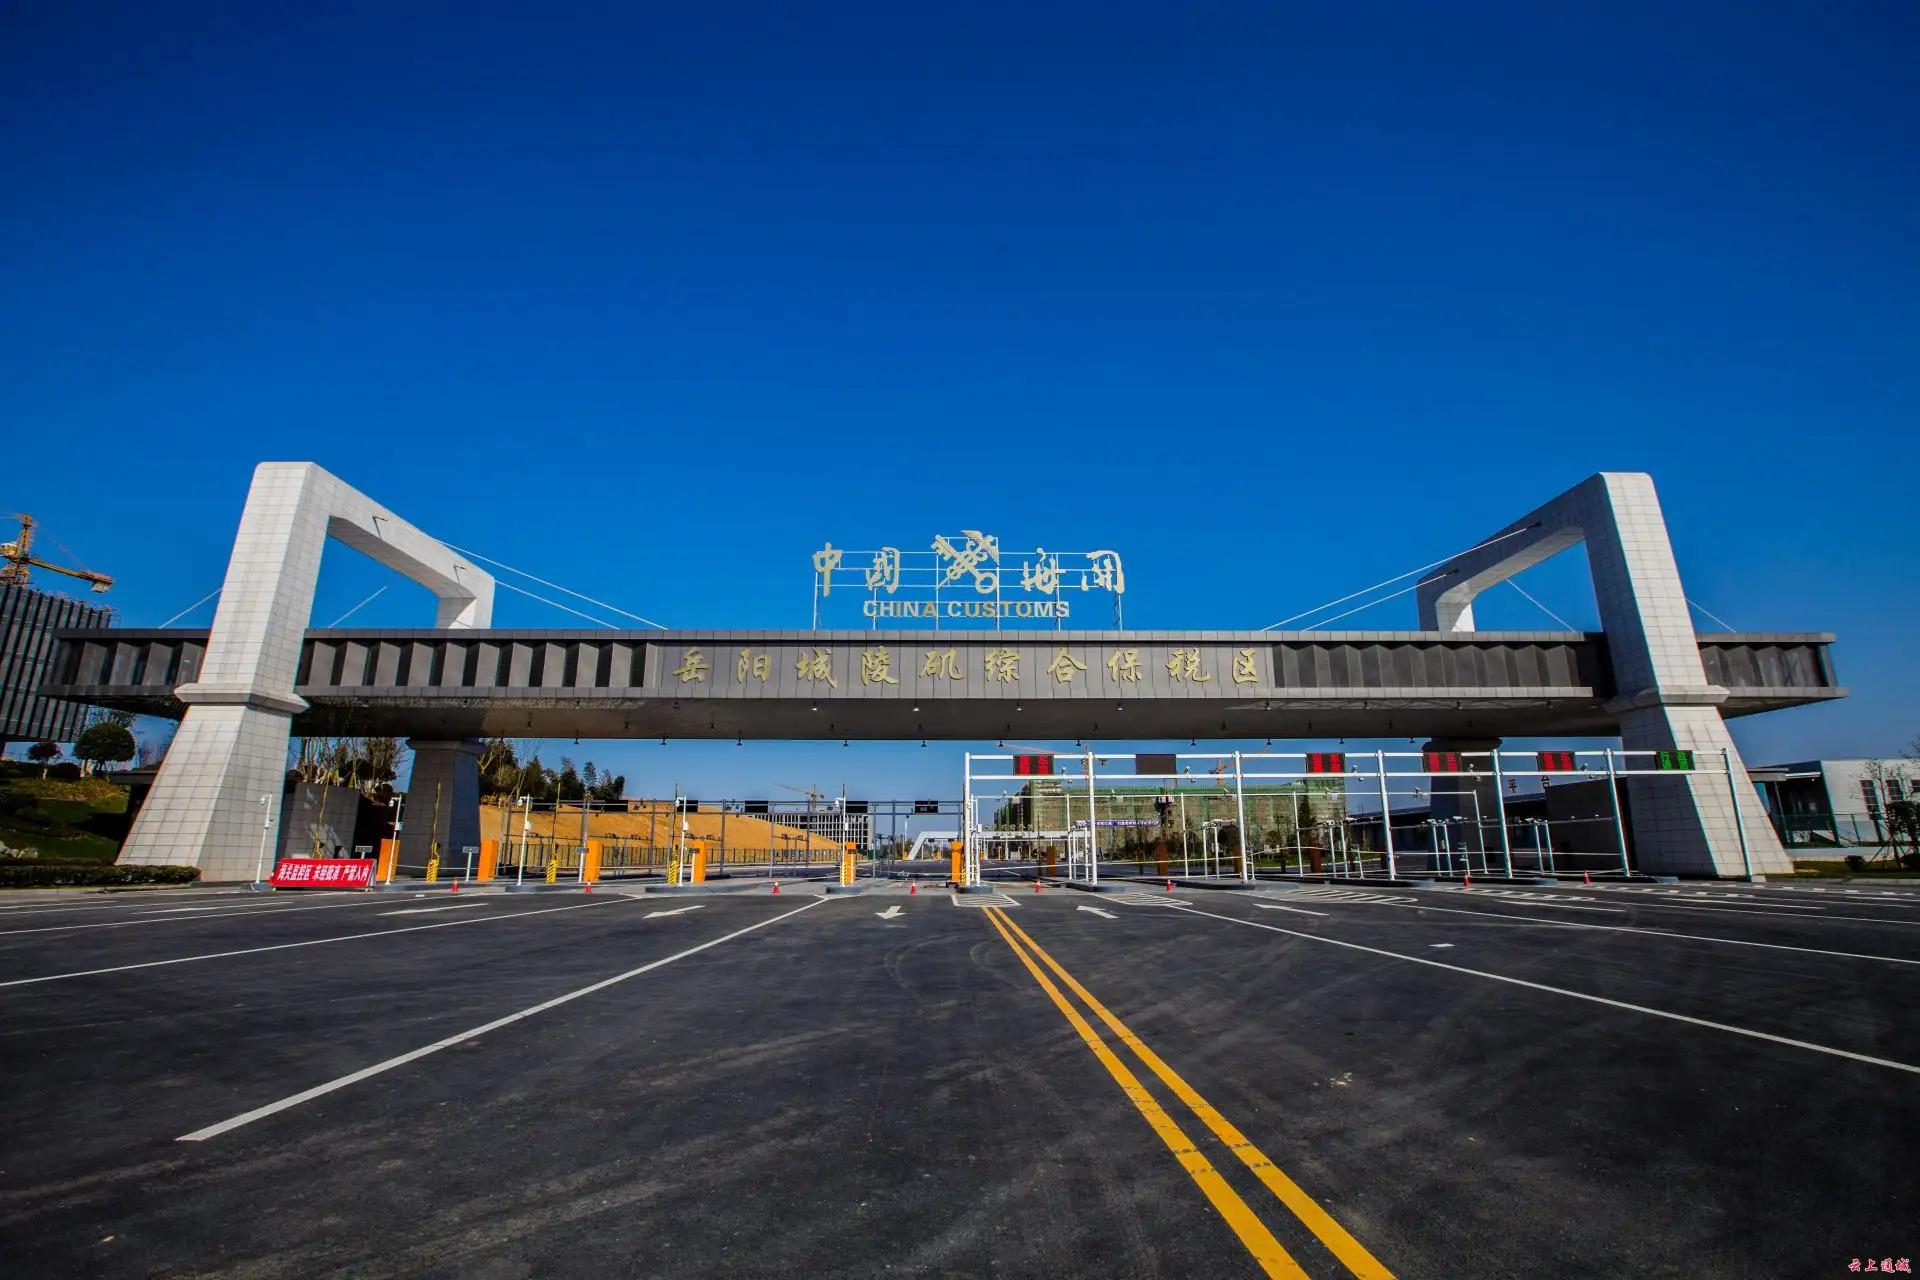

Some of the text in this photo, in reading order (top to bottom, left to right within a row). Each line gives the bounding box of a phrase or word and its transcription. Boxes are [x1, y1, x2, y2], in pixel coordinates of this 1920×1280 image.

[863, 600, 1069, 617] CHINA CUSTOMS
[672, 645, 1259, 687] 岳阳城陵矶综合保税区
[341, 864, 370, 882] 严禁入内
